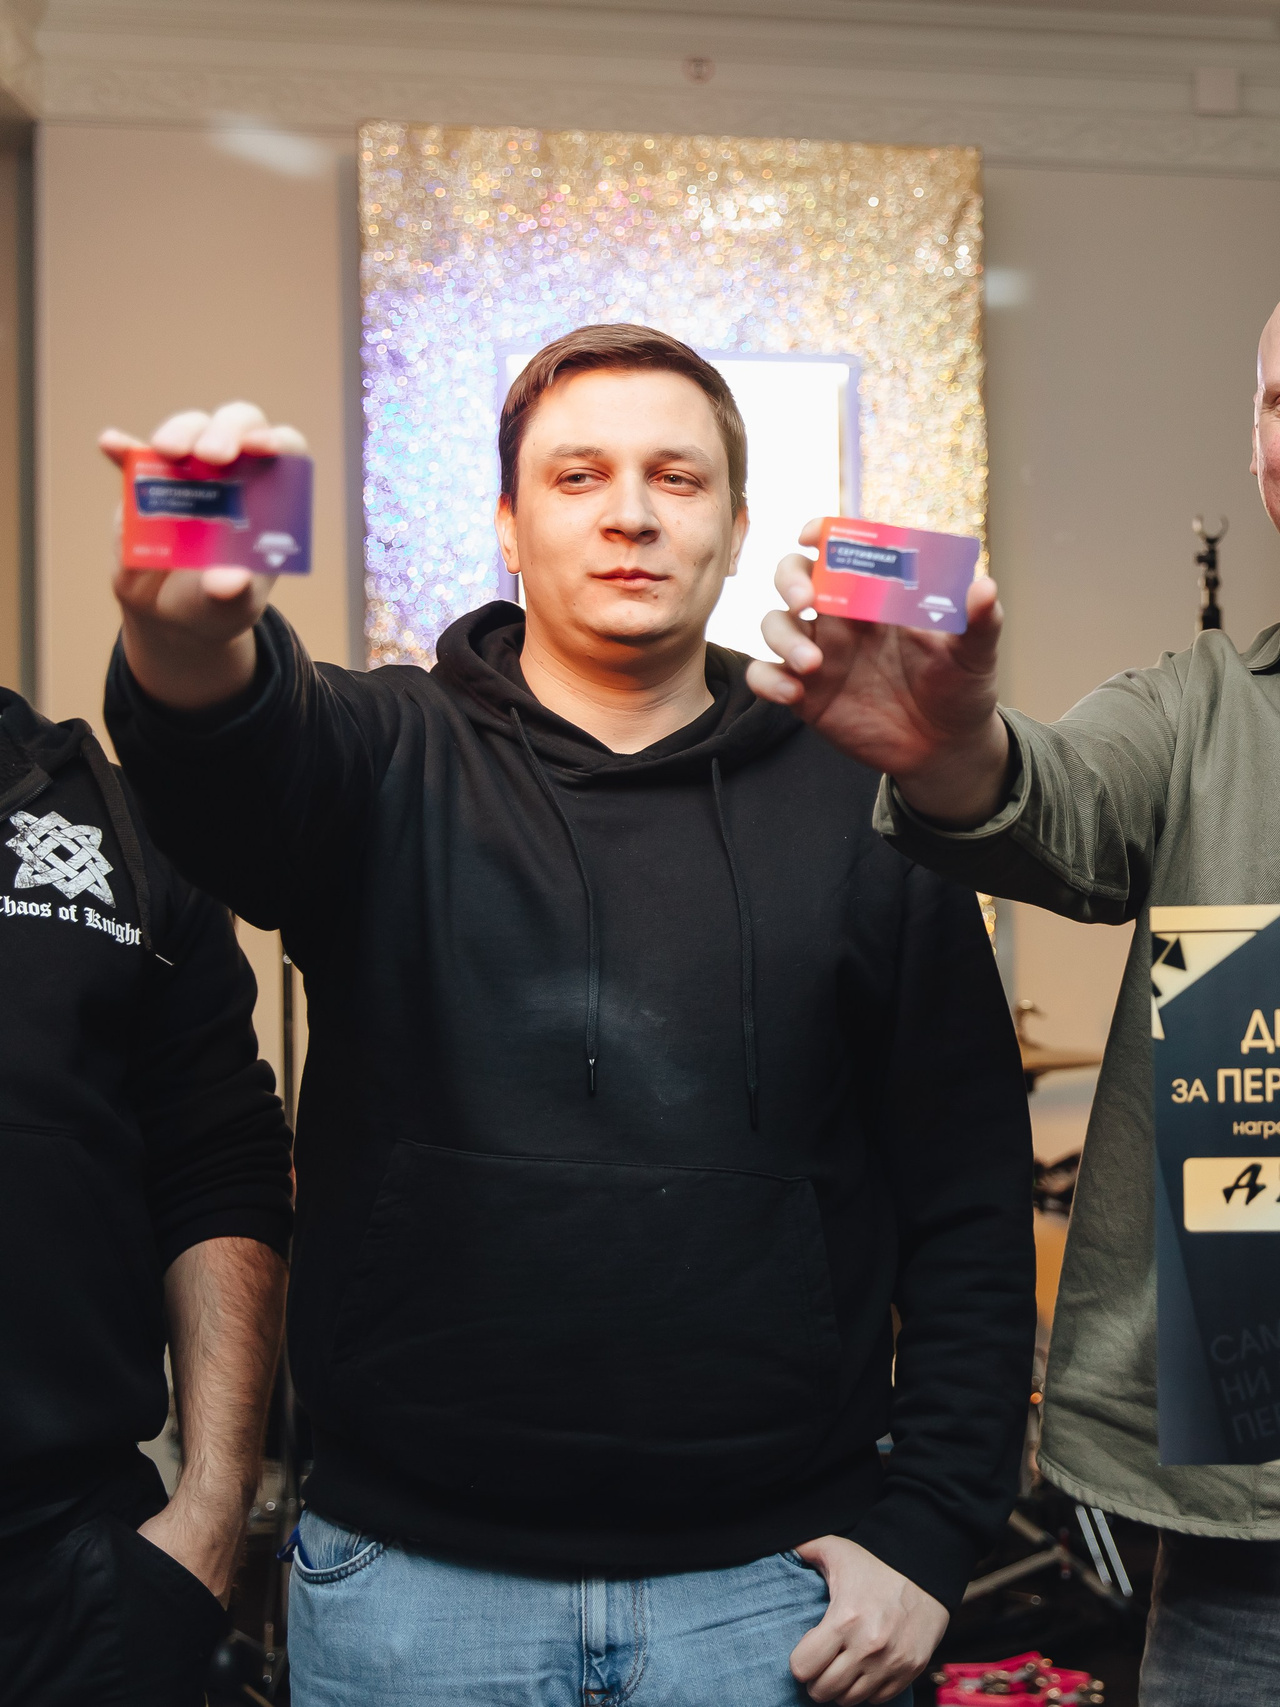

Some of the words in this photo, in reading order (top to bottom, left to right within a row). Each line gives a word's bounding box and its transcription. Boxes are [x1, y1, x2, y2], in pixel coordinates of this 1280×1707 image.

[58, 904, 79, 923] of
[1171, 1078, 1210, 1104] ЗА
[1220, 1363, 1272, 1407] НИ
